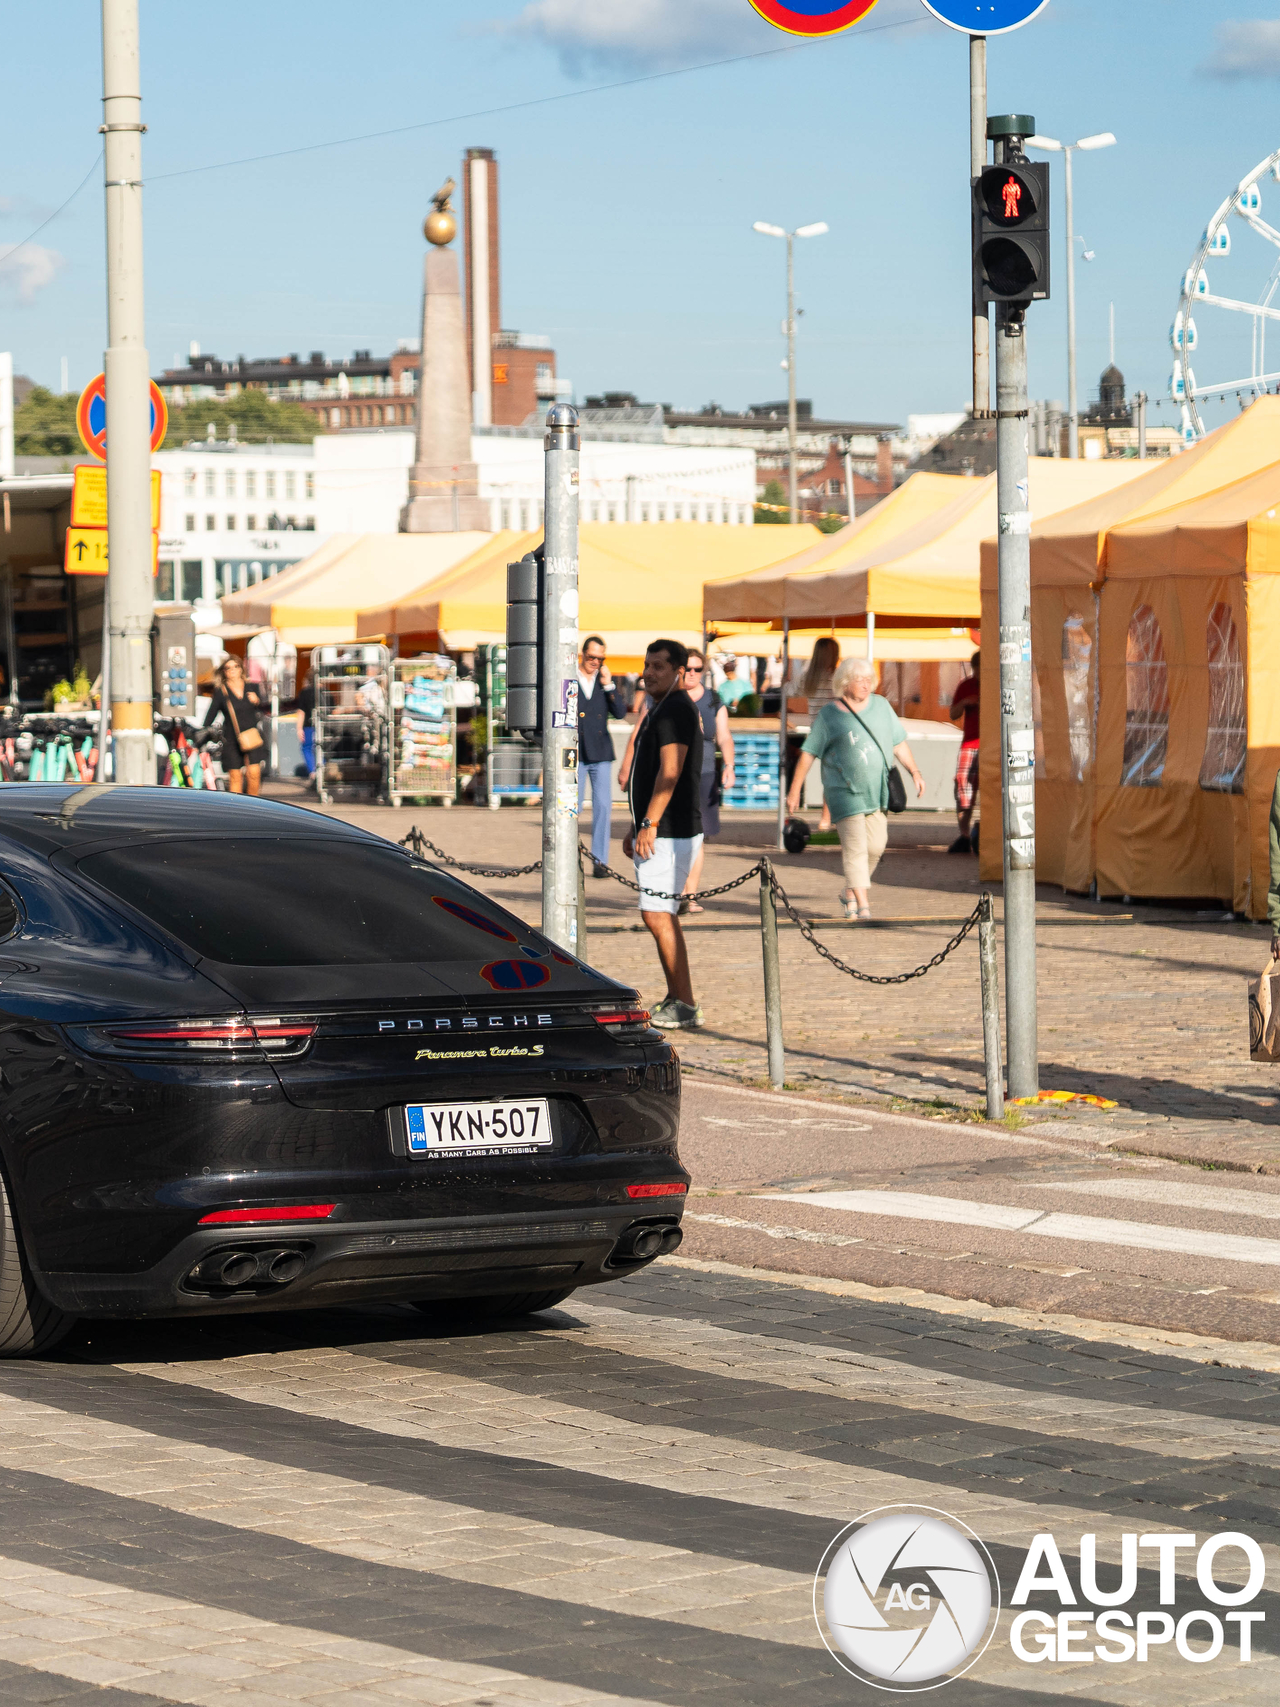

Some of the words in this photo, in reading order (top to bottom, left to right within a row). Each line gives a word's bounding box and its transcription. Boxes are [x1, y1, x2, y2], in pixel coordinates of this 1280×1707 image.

[378, 1014, 553, 1031] PORSCHE
[415, 1048, 487, 1061] Panamera
[528, 1044, 545, 1057] S
[430, 1106, 540, 1142] YKN-507
[411, 1131, 426, 1142] FIN
